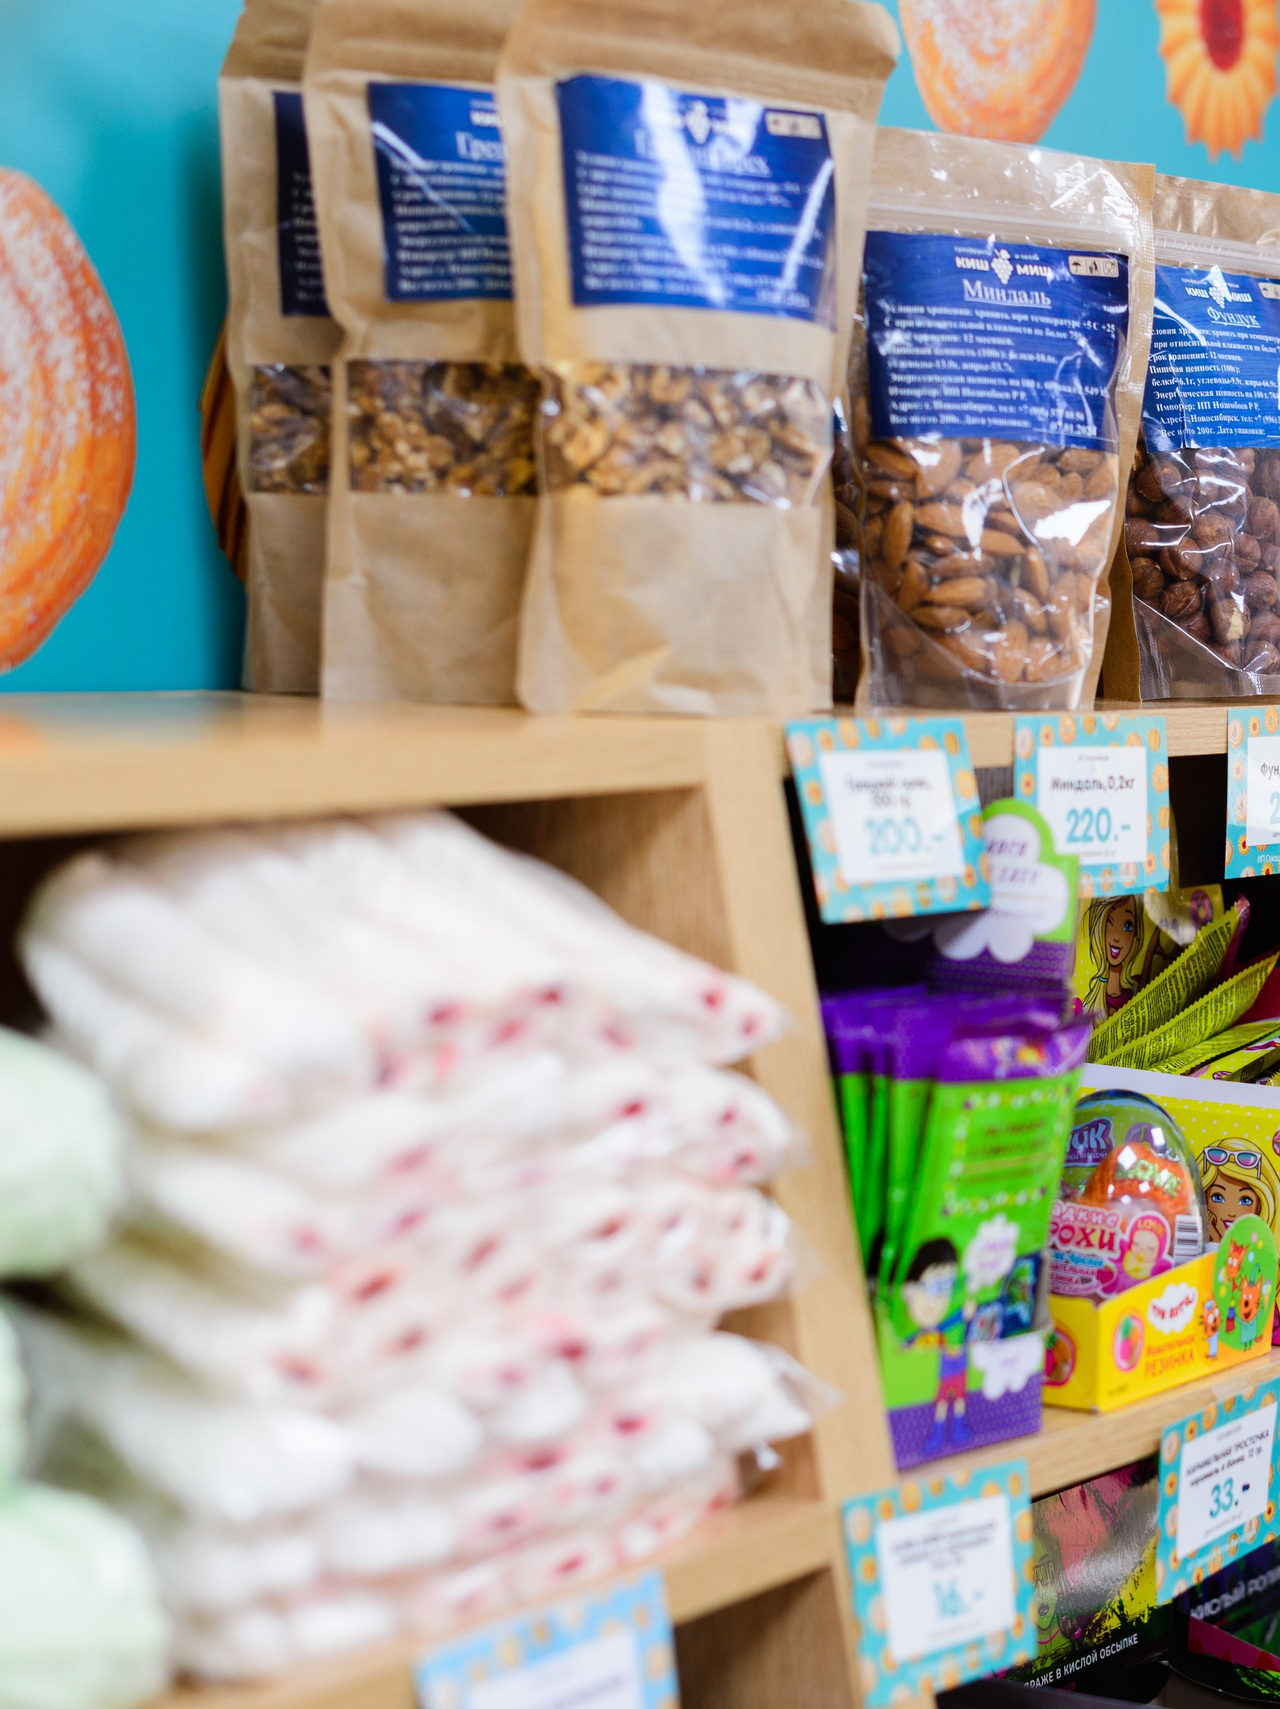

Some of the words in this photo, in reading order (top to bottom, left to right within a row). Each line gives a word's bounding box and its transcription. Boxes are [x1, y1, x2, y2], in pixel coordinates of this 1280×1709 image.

[955, 256, 989, 272] КИШ
[963, 278, 1052, 306] Миндаль
[1185, 287, 1209, 298] КИШ
[1207, 307, 1260, 326] Фундук
[1197, 401, 1211, 410] ИП
[1066, 807, 1131, 843] 220.-
[1144, 1349, 1194, 1378] РЕЗИНКА
[1210, 1477, 1250, 1518] 33.-
[1056, 1668, 1062, 1680] В
[1063, 1648, 1098, 1676] КИСЛОЙ
[1099, 1633, 1139, 1660] ОБСЫПКЕ
